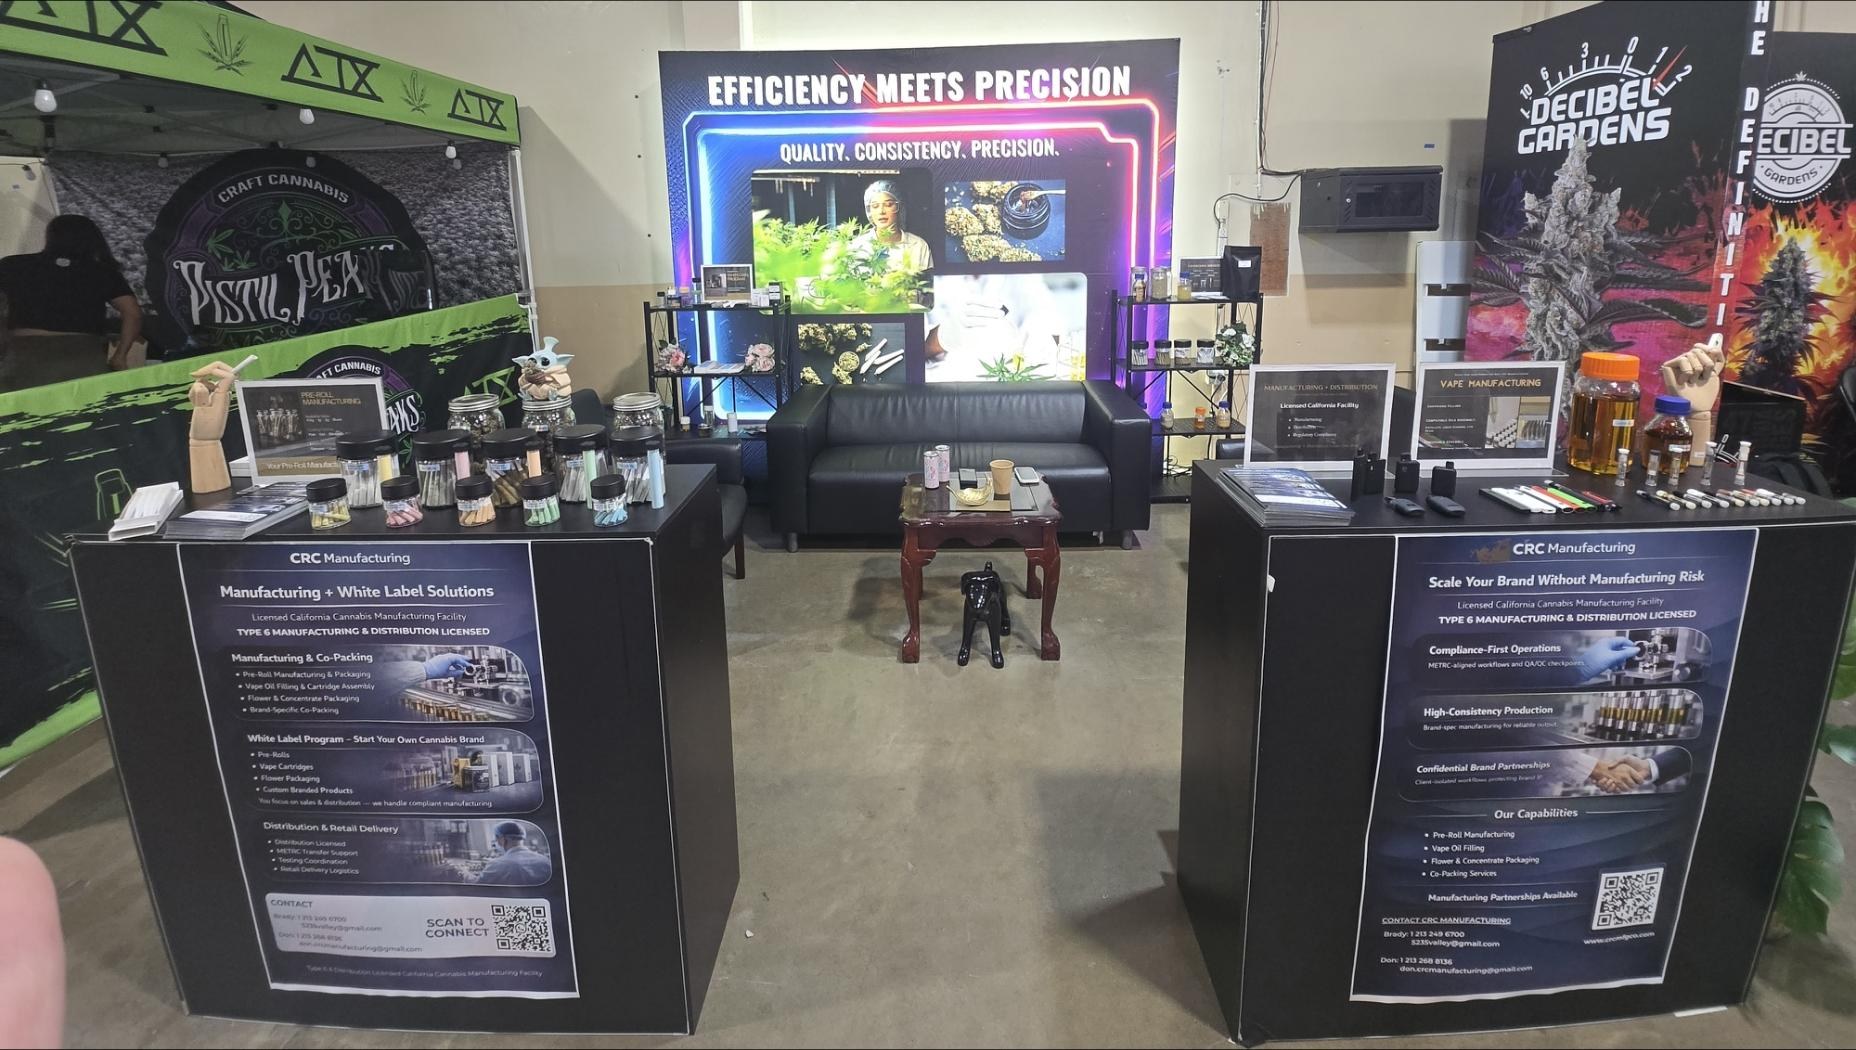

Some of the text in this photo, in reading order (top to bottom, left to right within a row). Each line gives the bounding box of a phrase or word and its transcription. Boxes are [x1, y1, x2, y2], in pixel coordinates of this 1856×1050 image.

[1519, 83, 1533, 100] 10
[1540, 67, 1549, 80] 6
[1581, 42, 1589, 58] 3
[1627, 36, 1639, 53] 0
[1676, 65, 1693, 82] 2
[707, 66, 1131, 106] EFFICIENCY MEETS PRECISION
[1531, 78, 1660, 125] DECIBEL
[1517, 107, 1672, 155] GARDENS
[1757, 129, 1852, 154] ECIBEL
[780, 138, 1060, 164] QUALITY. CONSISTENCY. PRECISION.
[1764, 167, 1819, 186] GARDENS
[218, 174, 349, 203] CRAFT CANNABIS
[173, 260, 292, 326] PISTIL
[334, 361, 382, 375] CANNABIS
[1440, 378, 1541, 389] VAPE MANUFACTURING
[1337, 402, 1359, 410] Facility
[1512, 542, 1636, 555] CRC Manufacturing
[290, 552, 410, 565] CRC Manufacturing
[1429, 570, 1705, 588] Scale Your Brand Without Manufacturing Risk
[220, 584, 494, 601] Manufacturing + White Label Solutions
[1457, 597, 1664, 609] Licensed California Cannabis Manufacturing Facility
[252, 612, 467, 623] Licensed California Cannabis Manufacturing Facility
[1438, 610, 1697, 624] TYPE 6 MANUFACTURING & DISTRIBUTION LICENSED
[237, 627, 490, 636] TYPE 6 MANUFACTURING & DISTRIBUTION LICENSED
[1429, 644, 1561, 656] Compliance-First Operations
[231, 653, 373, 665] Manufacturing & Co-Packing
[1428, 661, 1476, 670] METRC-aligned
[1524, 660, 1546, 668] QA/QC
[274, 671, 326, 679] Manufacturing
[335, 671, 371, 679] Packaging
[276, 683, 299, 691] Filling
[307, 683, 340, 691] Cartridge
[341, 683, 375, 691] Assembly
[323, 695, 360, 703] Packaging
[249, 706, 339, 715] Brand-Specific Co-Packing
[1423, 706, 1553, 719] High-Consistency Production
[247, 734, 485, 745] White Label Program Start Your Own Cannabis Brand
[278, 763, 313, 771] Cartridges
[1417, 761, 1551, 774] Confidential Brand Partnerships
[286, 775, 320, 783] Packaging
[1494, 808, 1578, 820] Our Capabilities
[263, 821, 319, 831] Distribution
[330, 824, 357, 832] Retail
[359, 825, 399, 834] Delivery
[1432, 831, 1515, 839] Pre-Roll Manufacturing
[1451, 844, 1462, 852] Oil
[1463, 844, 1485, 853] Filling
[1462, 857, 1504, 865] Concentrate
[1505, 856, 1539, 865] Packaging
[1430, 870, 1496, 879] Co-Packing Services
[1428, 890, 1578, 903] Manufacturing Partnerships Available
[271, 899, 312, 908] CONTACT
[426, 917, 485, 928] SCAN TO
[1382, 917, 1511, 926] CONTACT CRC MANUFACTURING
[425, 928, 490, 938] CONNECT
